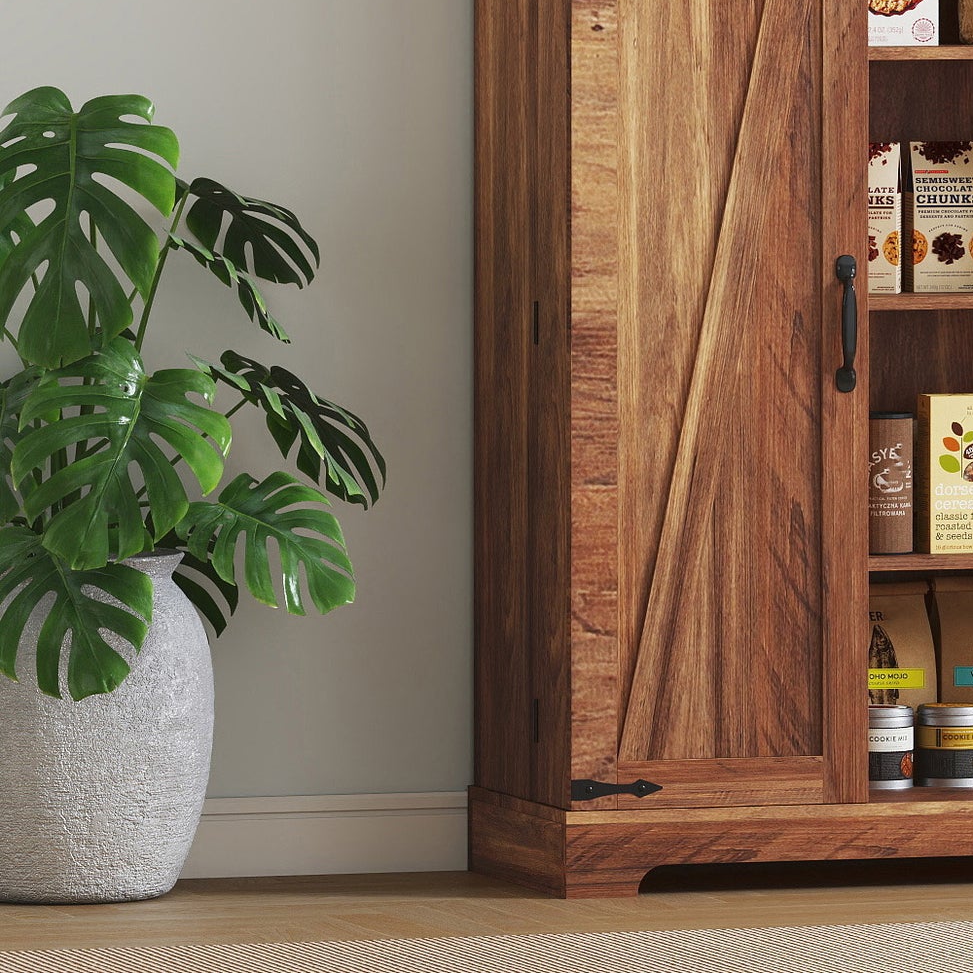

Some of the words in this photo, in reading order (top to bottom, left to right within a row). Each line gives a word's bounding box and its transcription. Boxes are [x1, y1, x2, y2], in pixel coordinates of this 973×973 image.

[935, 512, 968, 520] classic
[935, 522, 972, 530] roasted
[935, 532, 944, 540] &
[946, 531, 973, 540] seeds
[870, 612, 884, 621] ER
